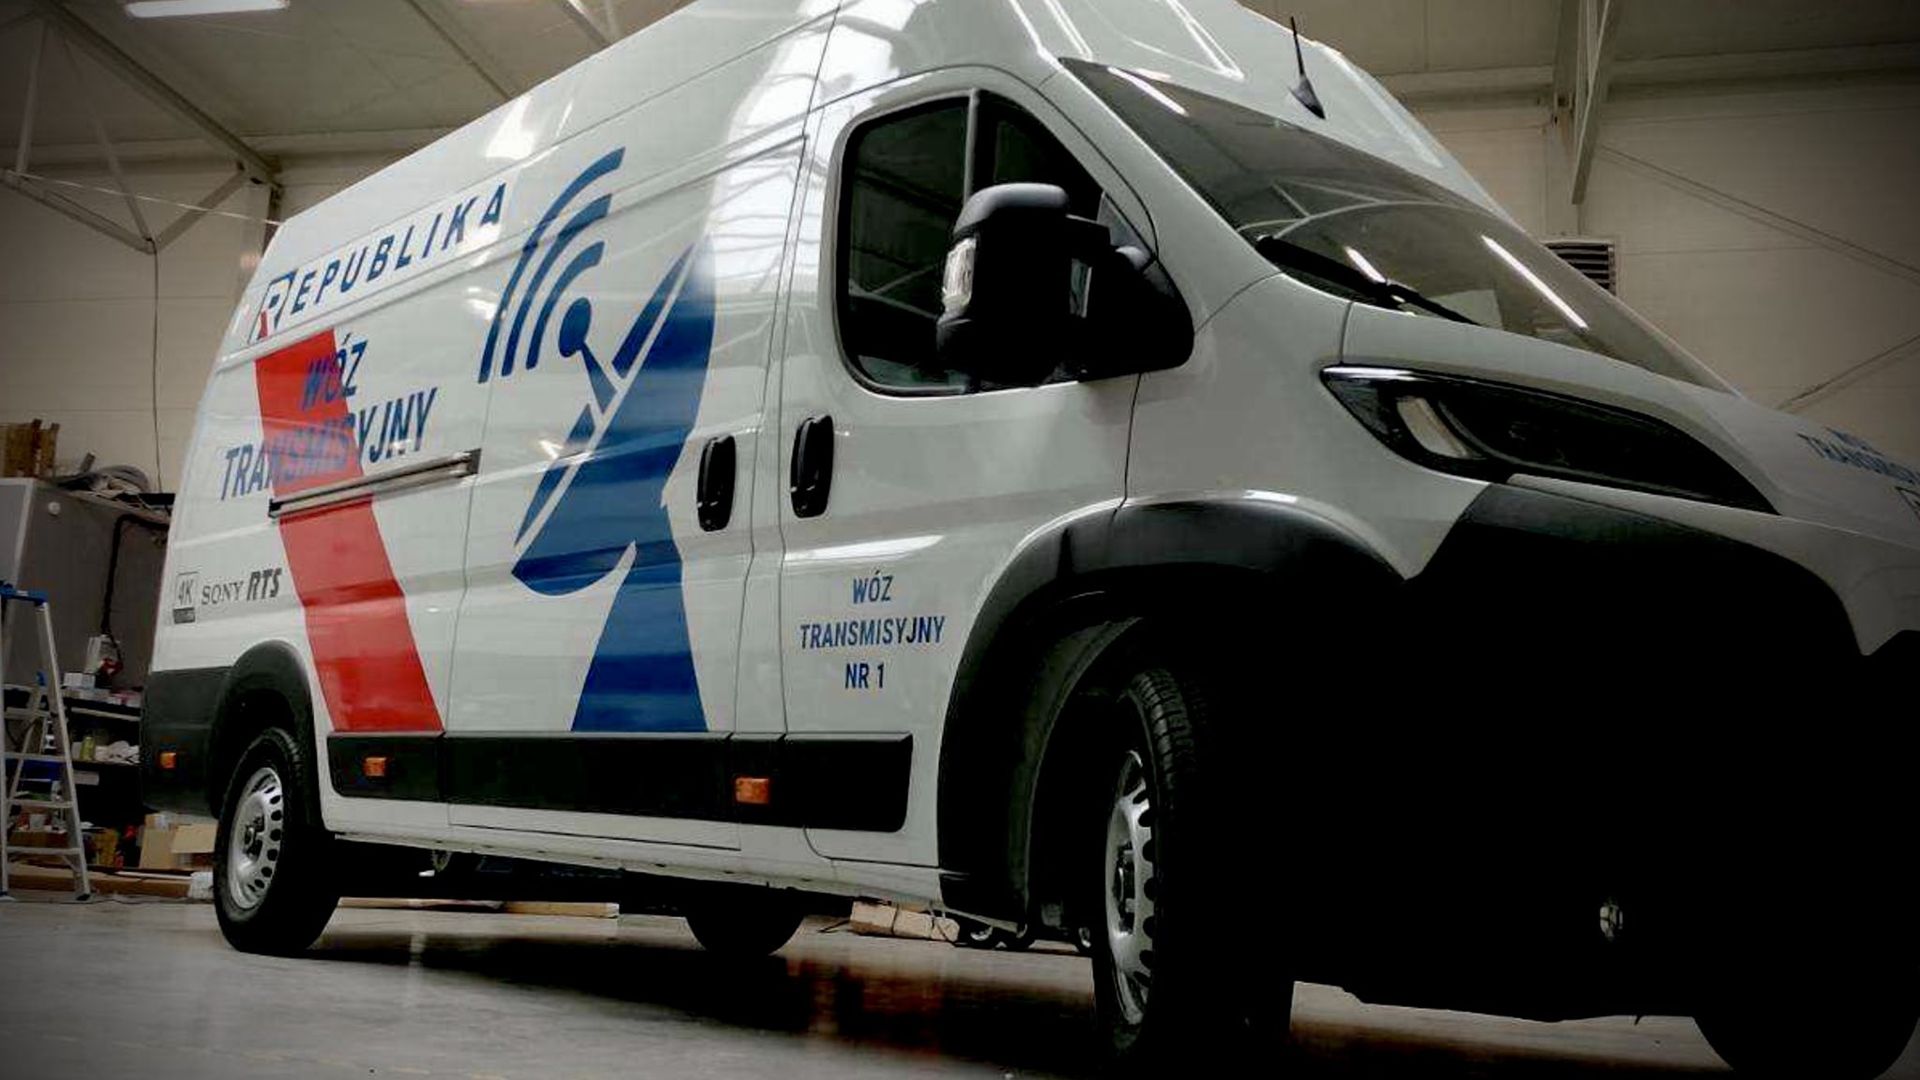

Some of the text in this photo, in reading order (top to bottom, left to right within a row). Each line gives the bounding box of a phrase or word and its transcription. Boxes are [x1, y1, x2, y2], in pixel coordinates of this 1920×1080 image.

[248, 182, 506, 345] REPUBLIKA
[302, 332, 368, 411] WÓZ
[220, 387, 438, 500] TRANSMISYJNY
[201, 579, 244, 605] SONY
[246, 566, 283, 601] RTS
[852, 569, 894, 604] WÓZ
[800, 615, 946, 649] TRANSMISYJNY
[845, 662, 885, 689] NR 1
